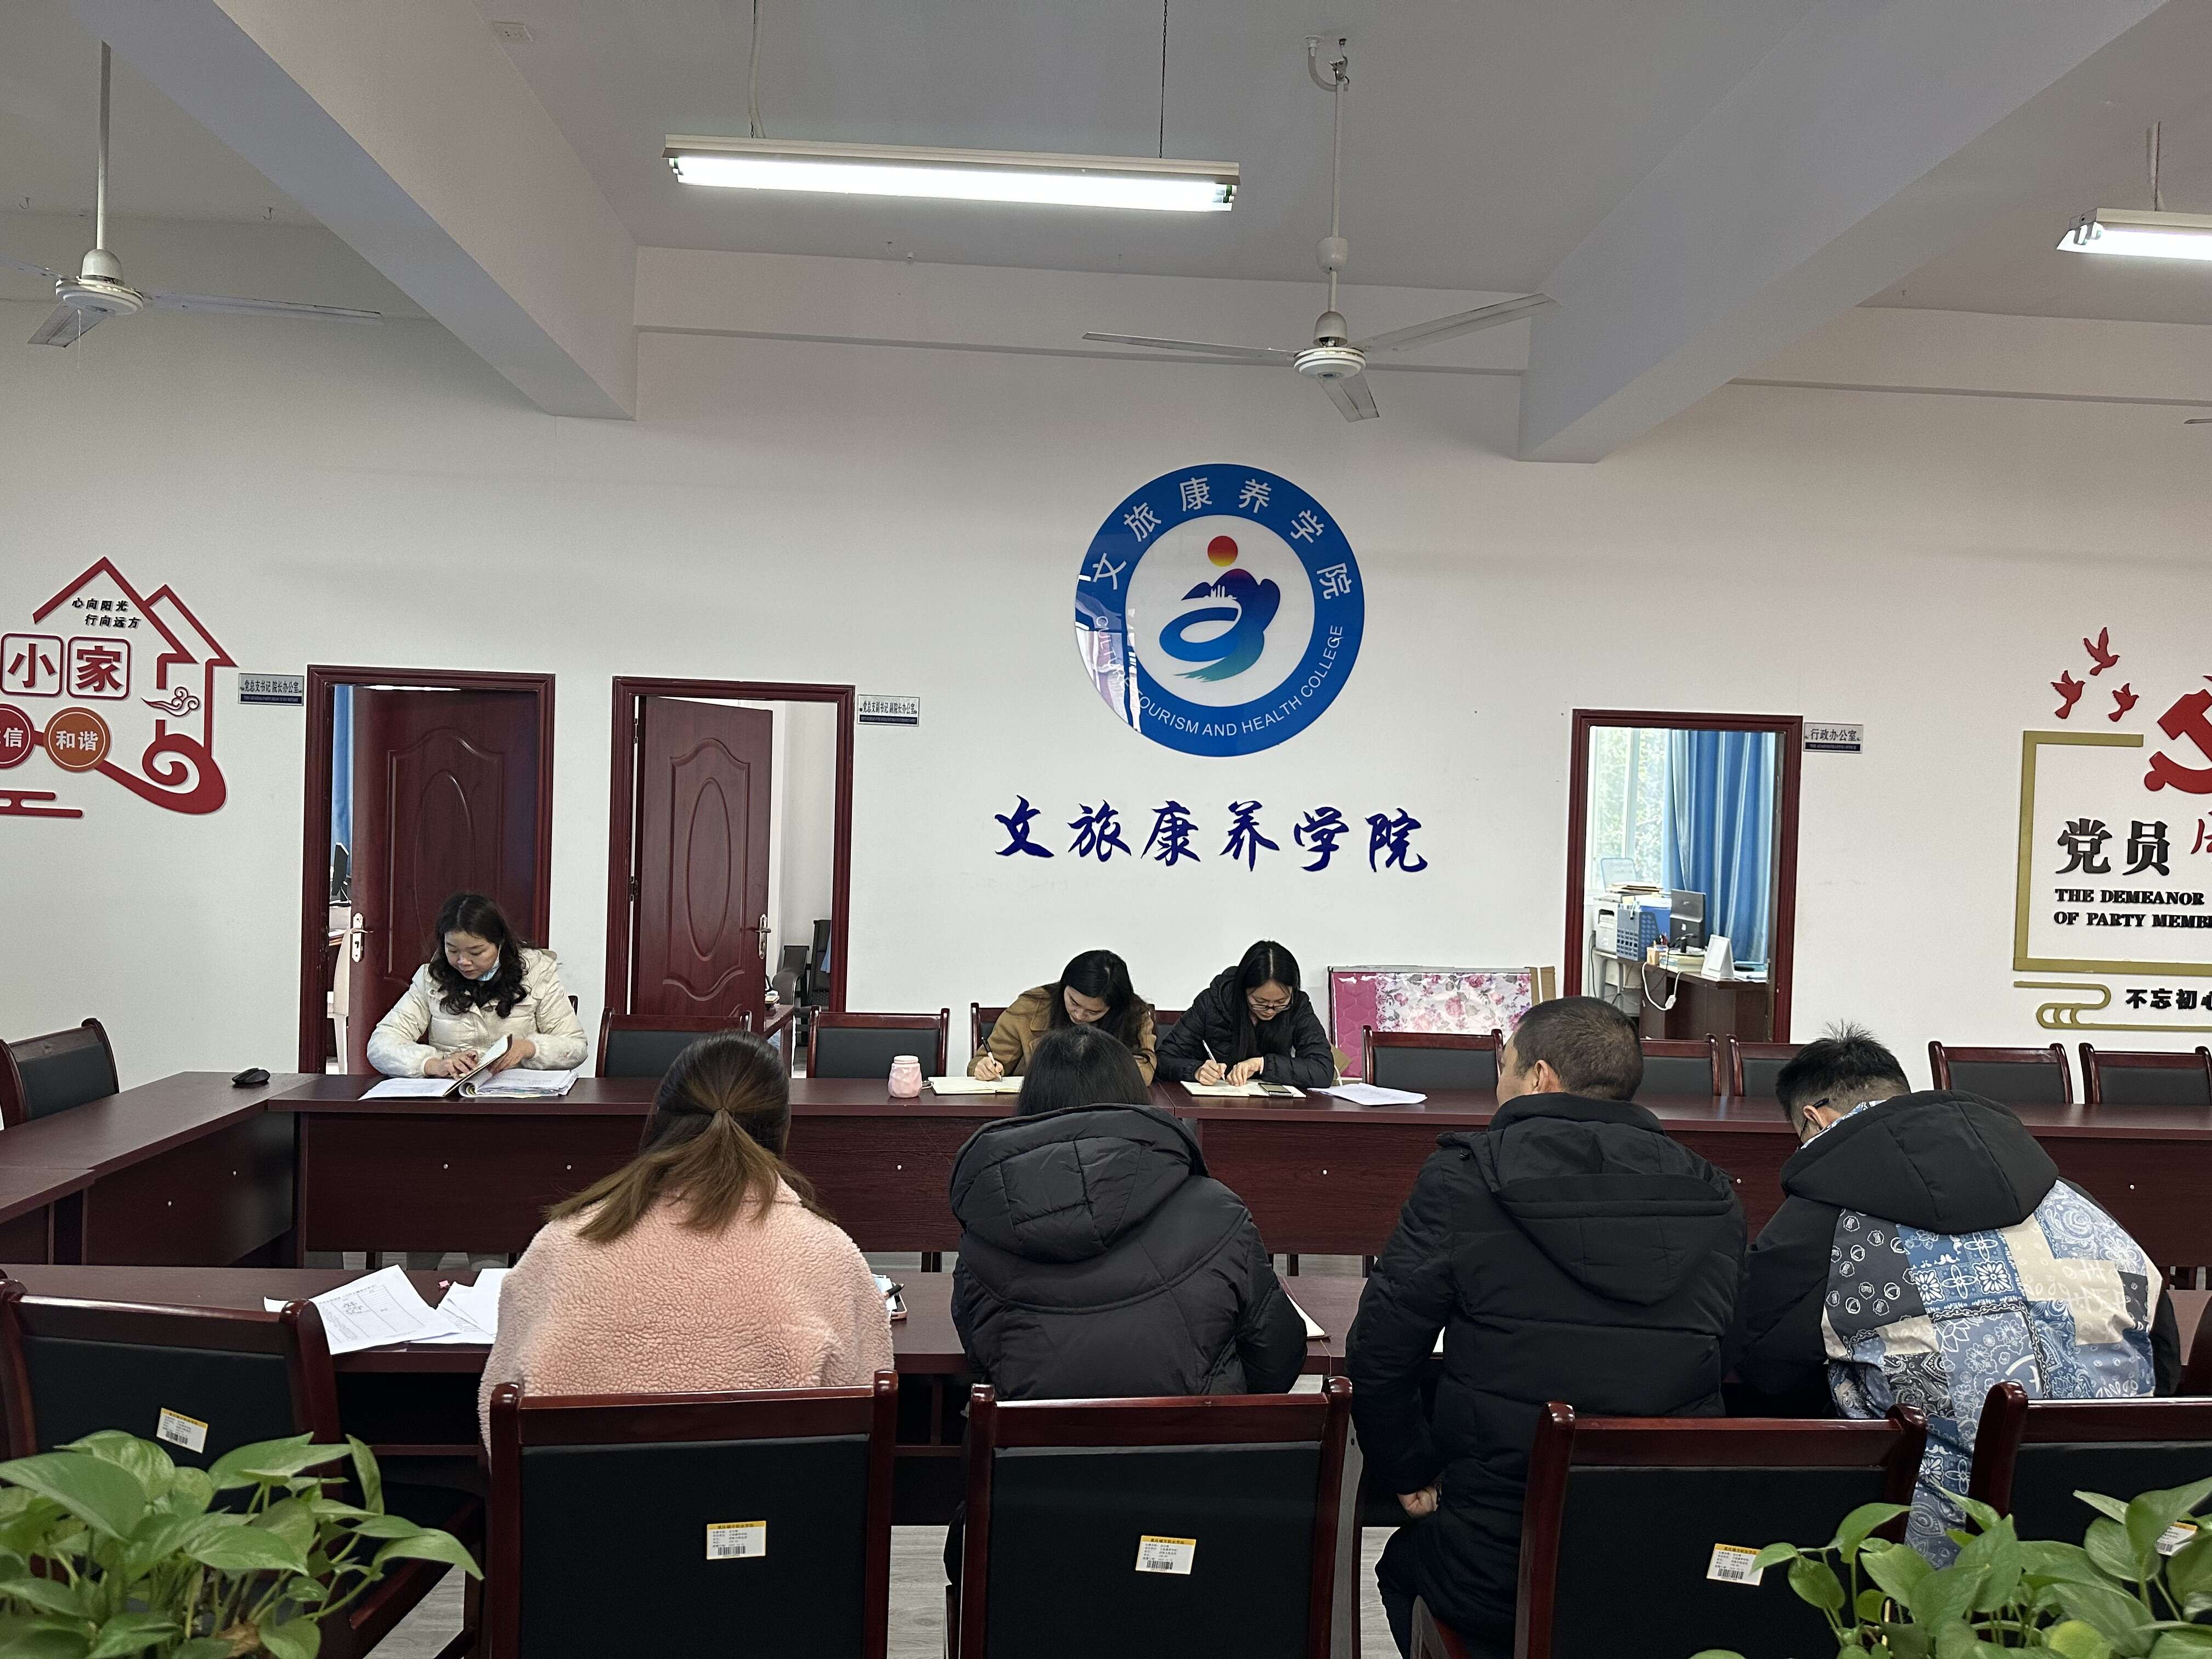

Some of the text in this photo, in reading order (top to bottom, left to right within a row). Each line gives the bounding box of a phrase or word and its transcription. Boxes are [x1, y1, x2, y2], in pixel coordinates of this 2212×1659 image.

[1092, 477, 1352, 600] 文旅康养学院
[72, 597, 129, 612] 心向阳光
[85, 613, 140, 628] 行向远方
[8, 643, 123, 692] 小家
[1138, 689, 1199, 735] OURISM
[1202, 723, 1237, 736] AND
[1242, 696, 1302, 733] HEALTH
[1300, 625, 1343, 698] COLLEGE
[0, 727, 24, 748] 信
[56, 730, 99, 751] 和谐
[1810, 729, 1857, 741] 行政办公室
[994, 794, 1428, 872] 文旅康养学院
[2056, 818, 2170, 876] 党员
[2055, 889, 2204, 905] THE DEMEANOR
[2053, 911, 2079, 925] OF
[2086, 912, 2147, 927] PARTY
